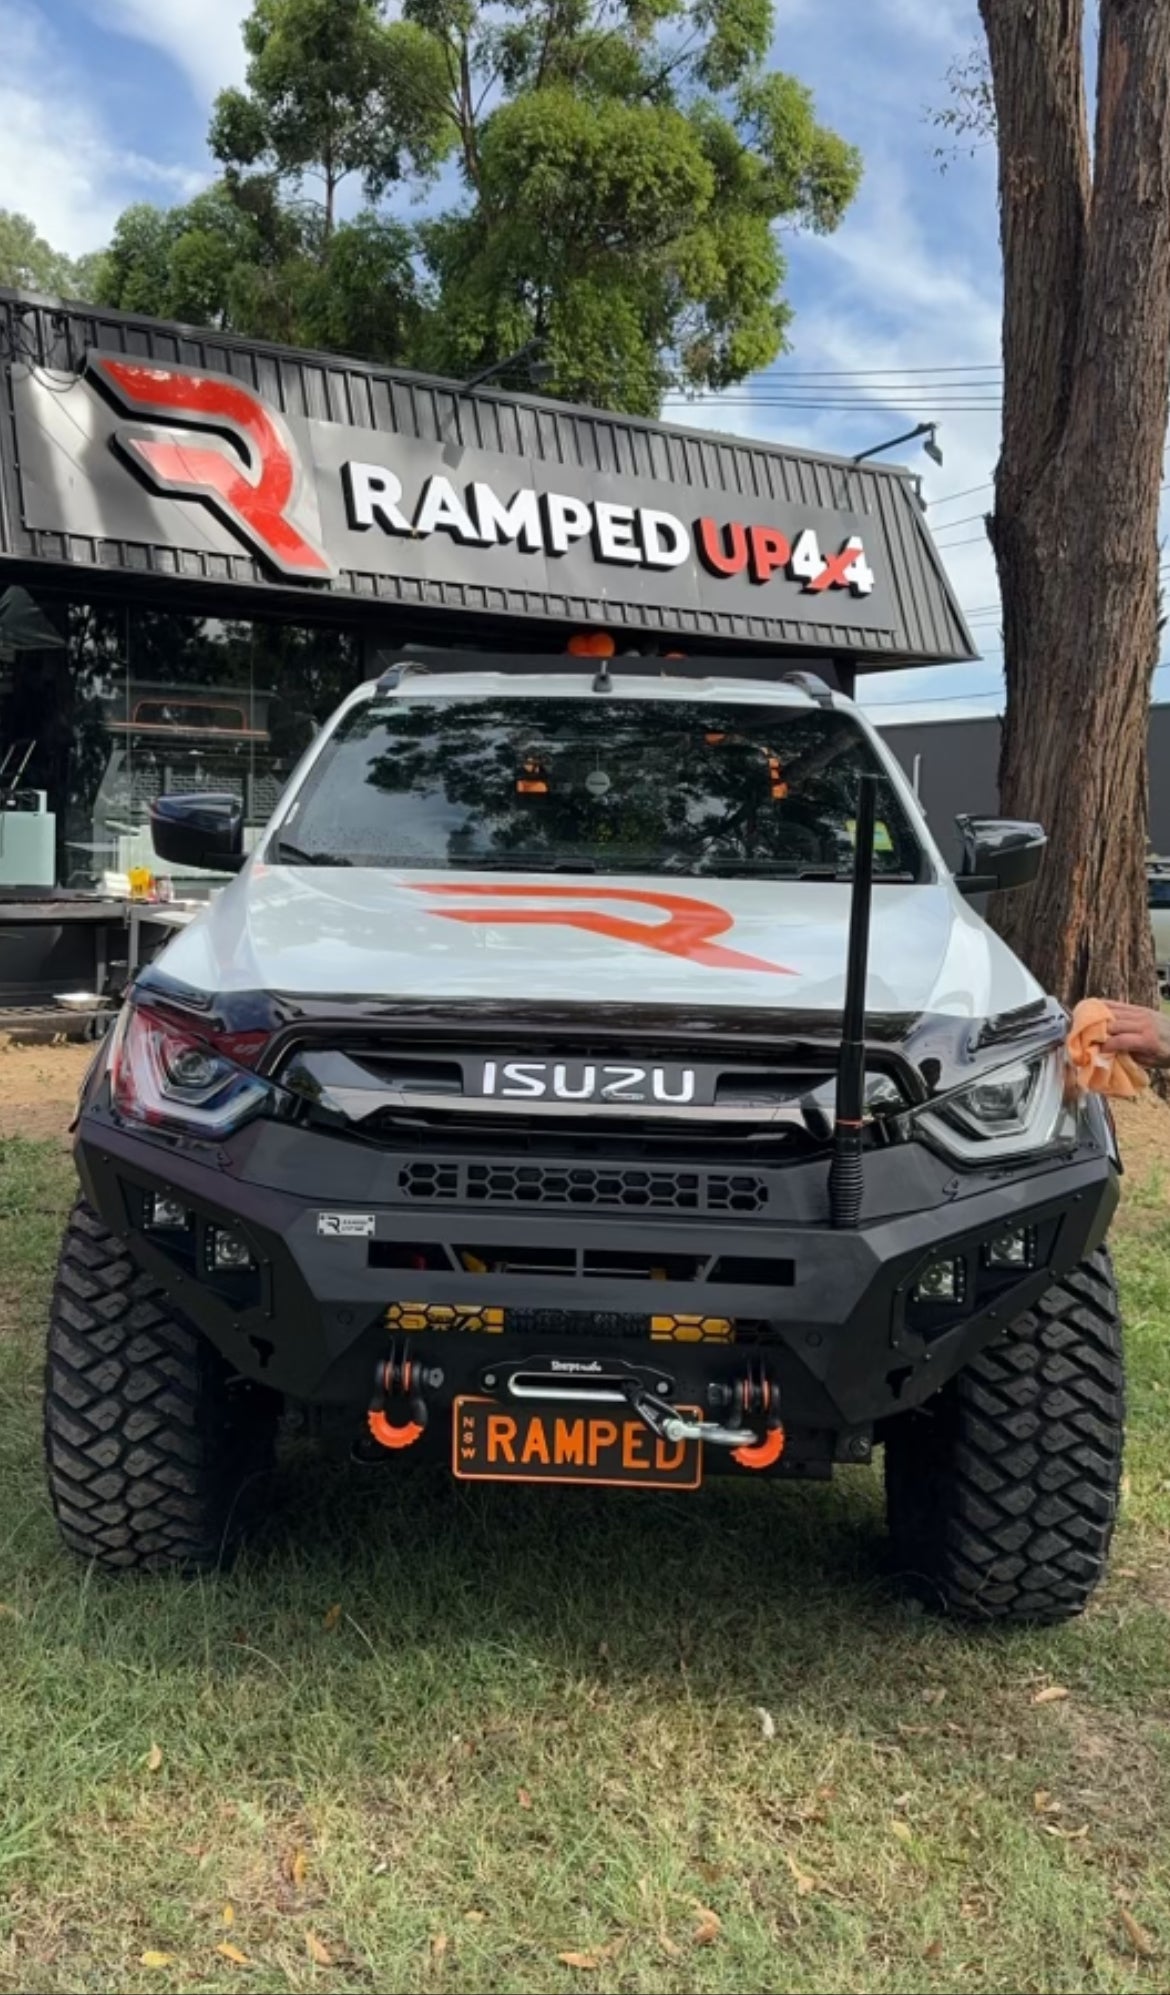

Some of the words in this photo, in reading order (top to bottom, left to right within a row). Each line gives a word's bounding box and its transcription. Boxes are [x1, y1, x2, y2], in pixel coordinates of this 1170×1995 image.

[345, 460, 691, 567] RAMPED
[482, 1061, 695, 1103] ISUZU
[461, 1416, 476, 1459] NSW
[486, 1414, 687, 1470] RAMPED
